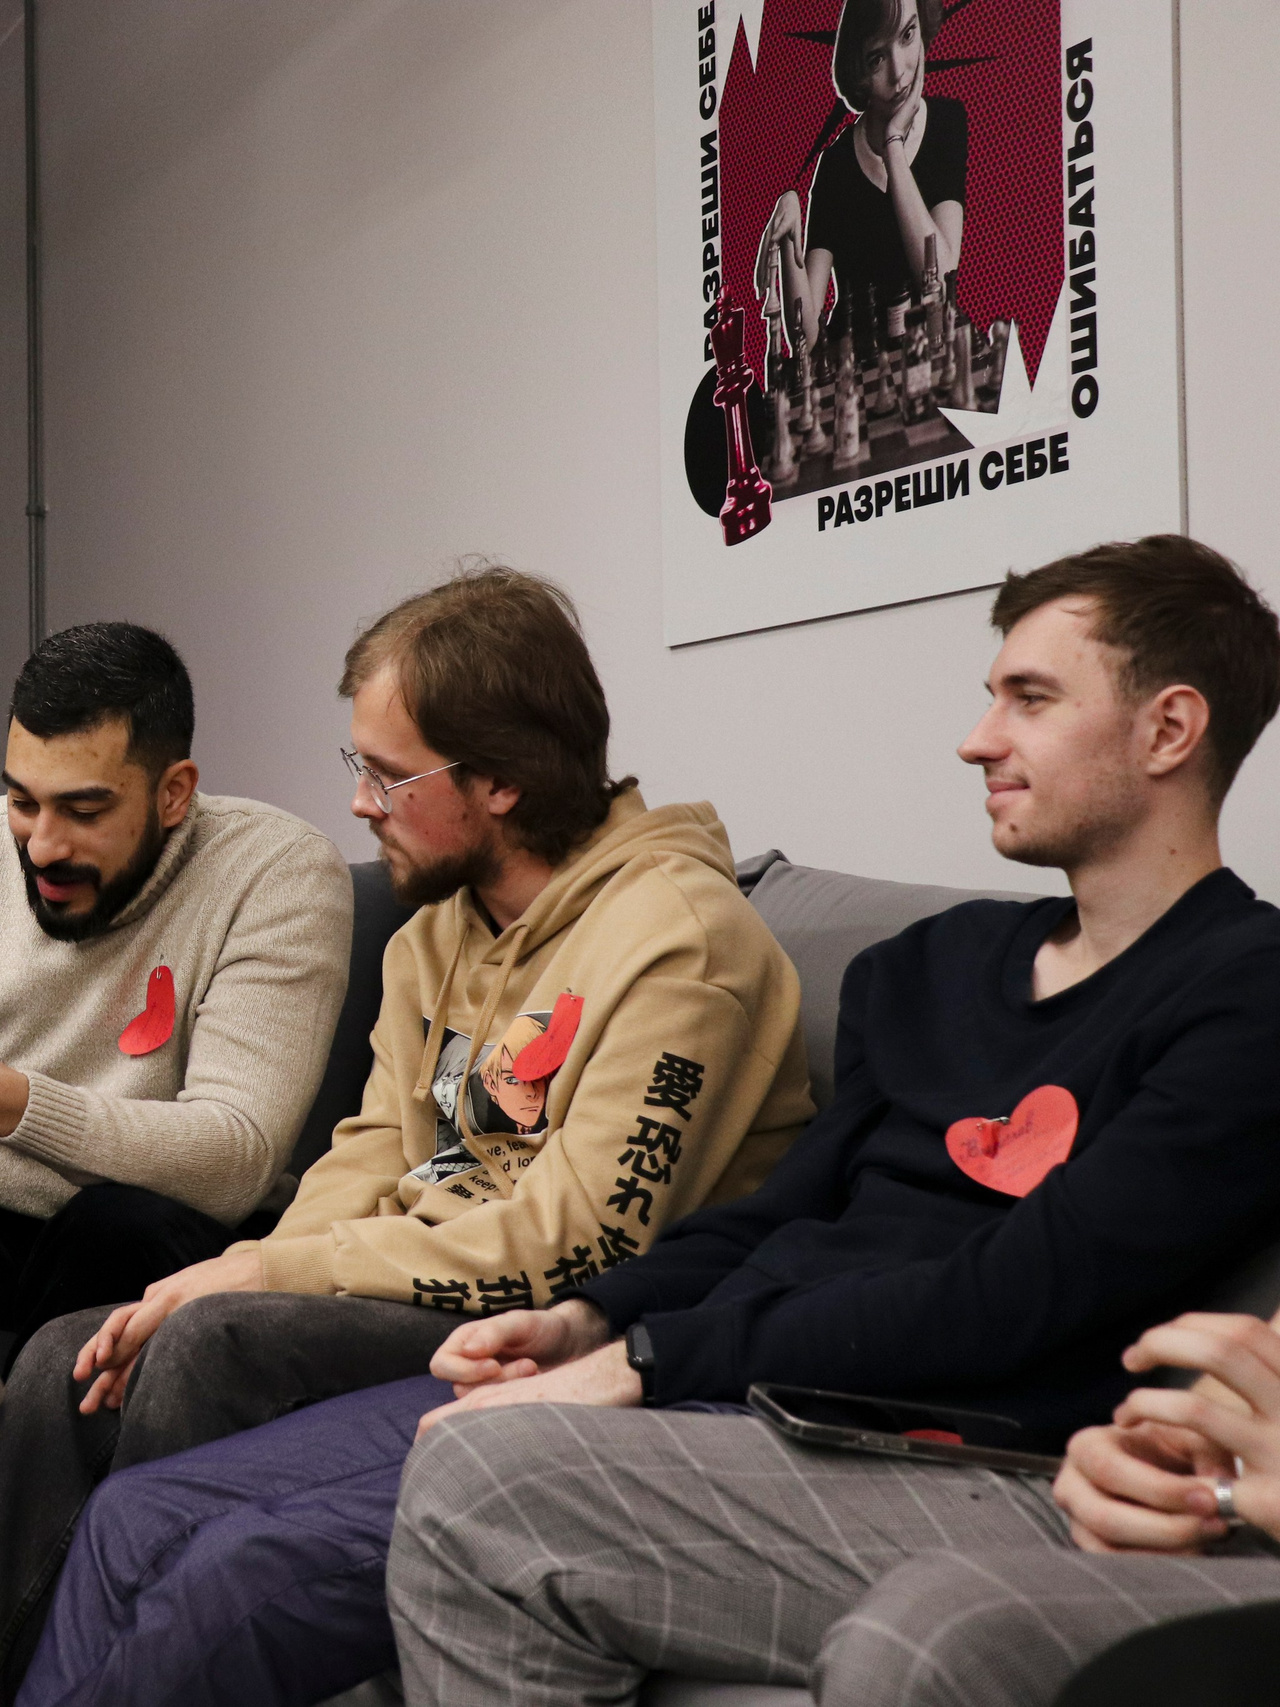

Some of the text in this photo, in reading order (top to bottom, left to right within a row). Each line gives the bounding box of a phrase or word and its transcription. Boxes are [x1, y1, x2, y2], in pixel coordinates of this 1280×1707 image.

[698, 0, 718, 121] СЕБЕ
[1065, 37, 1100, 419] ОШИБАТЬСЯ
[817, 432, 1070, 532] РАЗРЕШИ СЕБЕ
